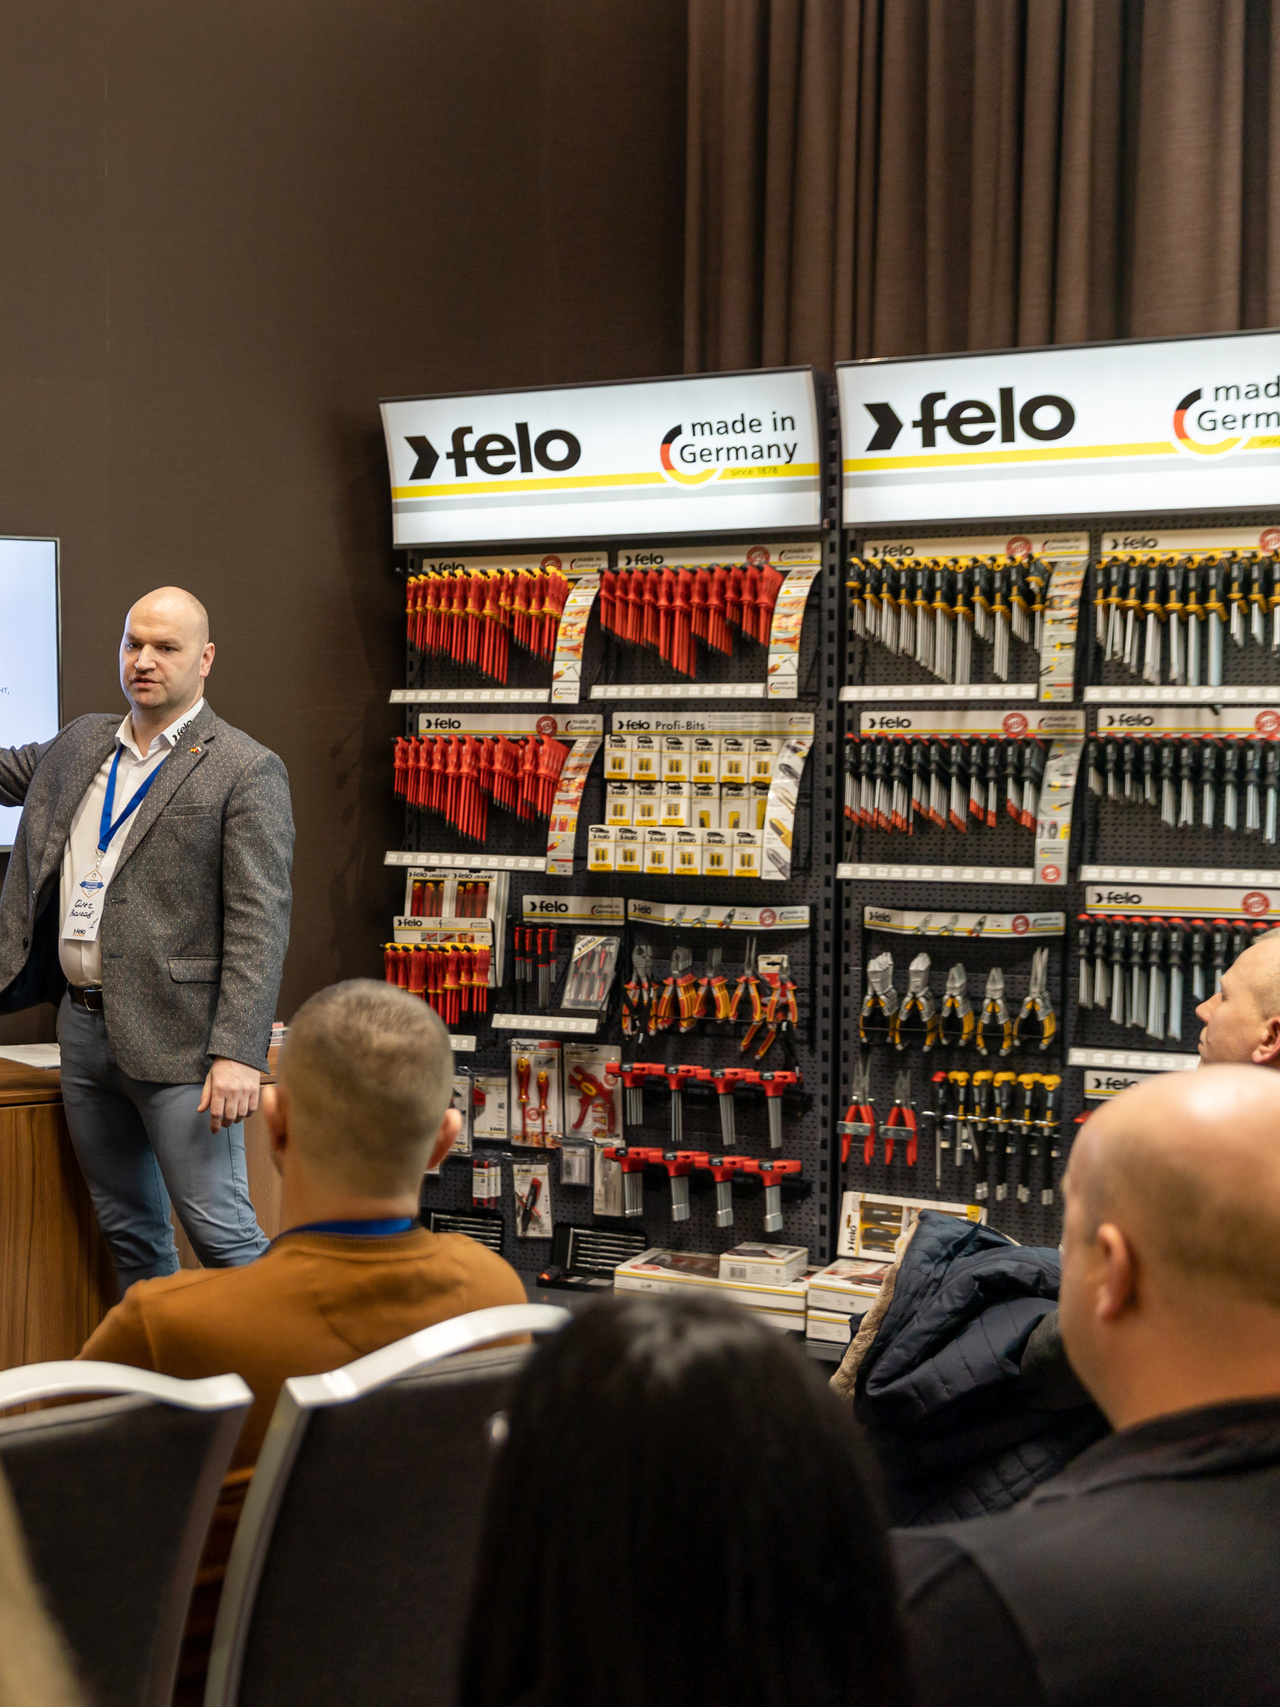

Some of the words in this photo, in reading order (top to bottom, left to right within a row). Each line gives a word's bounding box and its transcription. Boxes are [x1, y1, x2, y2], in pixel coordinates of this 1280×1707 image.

[1214, 374, 1280, 401] mad
[691, 413, 762, 436] made
[772, 411, 795, 432] in
[912, 386, 1076, 448] felo
[1197, 410, 1280, 431] Germ
[446, 422, 582, 478] felo
[679, 442, 798, 465] Germany
[730, 468, 753, 477] since
[757, 466, 779, 475] 1878
[1122, 537, 1158, 549] felo
[882, 545, 914, 557] felo
[634, 553, 664, 566] felo
[434, 718, 461, 730] felo
[626, 719, 650, 731] felo
[655, 720, 705, 731] Profi-Bits
[878, 716, 911, 729] felo
[1120, 713, 1154, 727] felo
[1107, 891, 1142, 904] felo
[539, 900, 569, 913] felo
[403, 918, 423, 927] felo
[847, 1225, 857, 1243] felo
